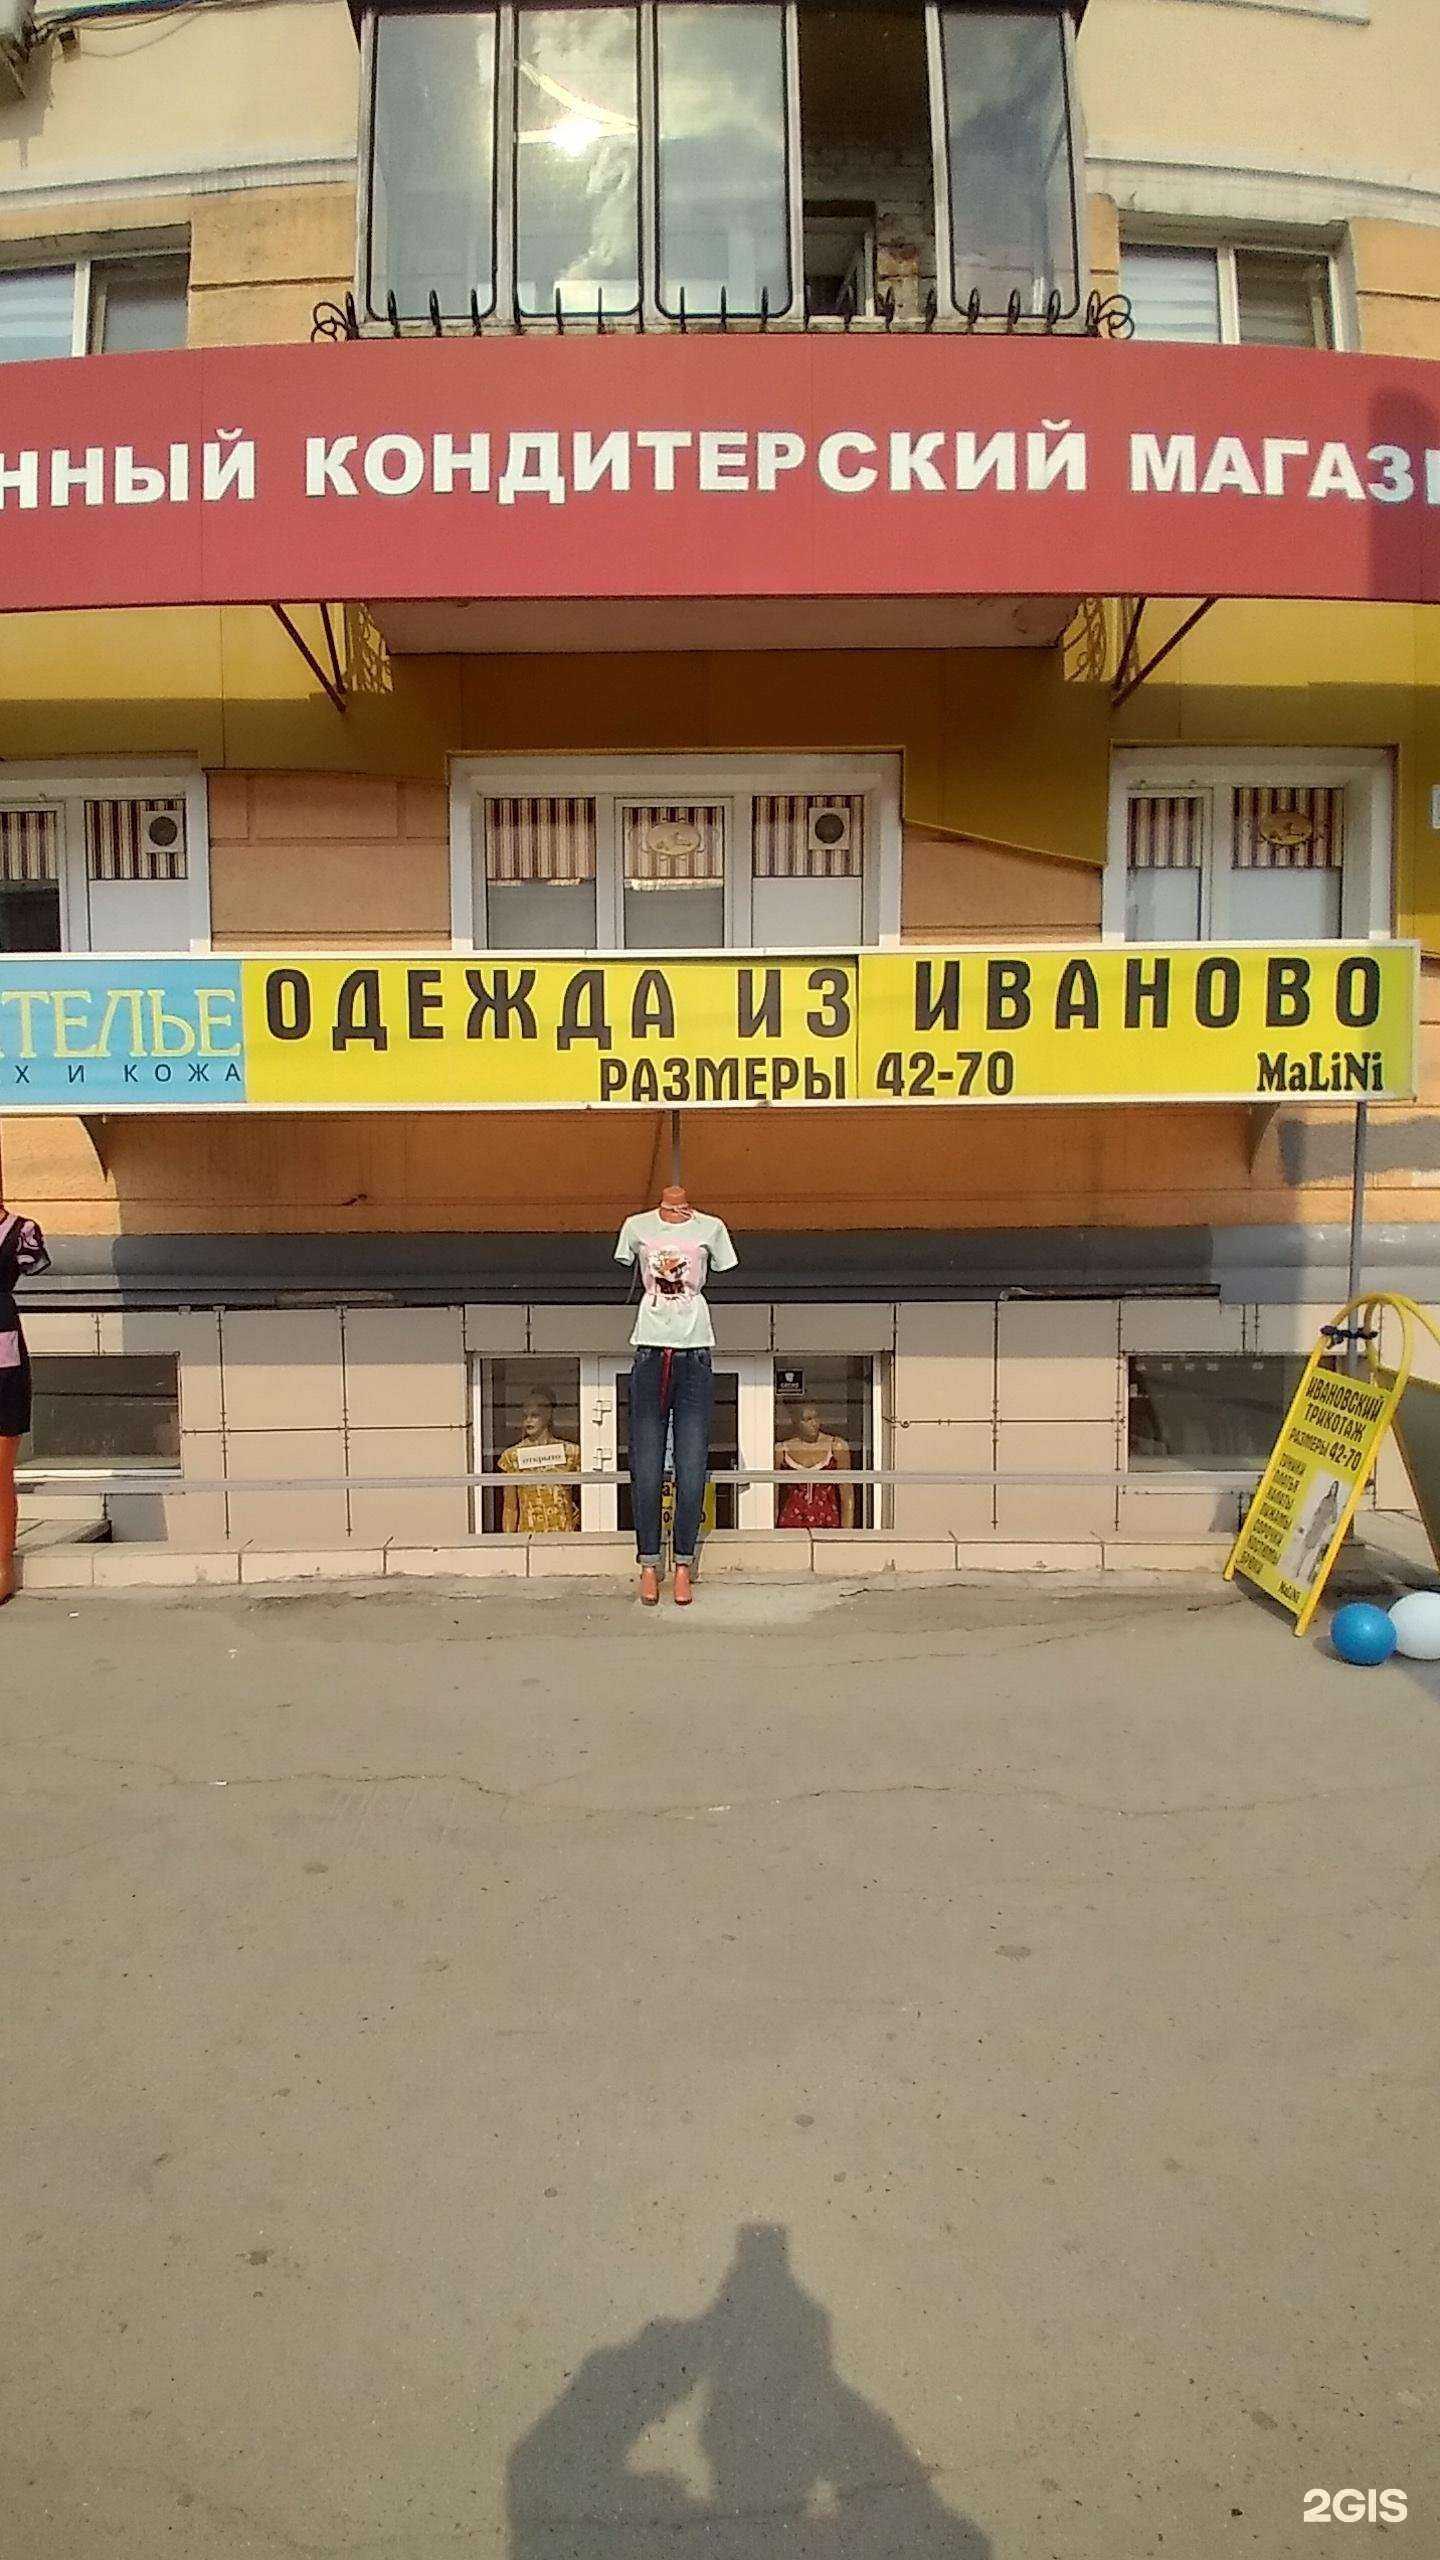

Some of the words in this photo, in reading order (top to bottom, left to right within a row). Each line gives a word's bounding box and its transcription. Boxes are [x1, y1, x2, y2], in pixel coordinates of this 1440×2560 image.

[305, 418, 1087, 505] КОНДИТЕРСКИЙ
[0, 988, 241, 1059] ТЕЛЬЕ
[265, 967, 676, 1052] ОДЕЖДА
[737, 968, 851, 1038] ИЗ
[914, 956, 1380, 1032] ИВАНОВО
[68, 1064, 86, 1083] И
[123, 1062, 242, 1084] КОЖА
[600, 1056, 847, 1101] РАЗМЕРЫ
[875, 1050, 1015, 1097] 42-70
[1256, 1051, 1384, 1093] MaLiNi
[1304, 1401, 1367, 1443] ТРИКОТАЖ
[1305, 1375, 1385, 1423] ИВАНОВСКИЙ
[1328, 1440, 1363, 1472] 42-70
